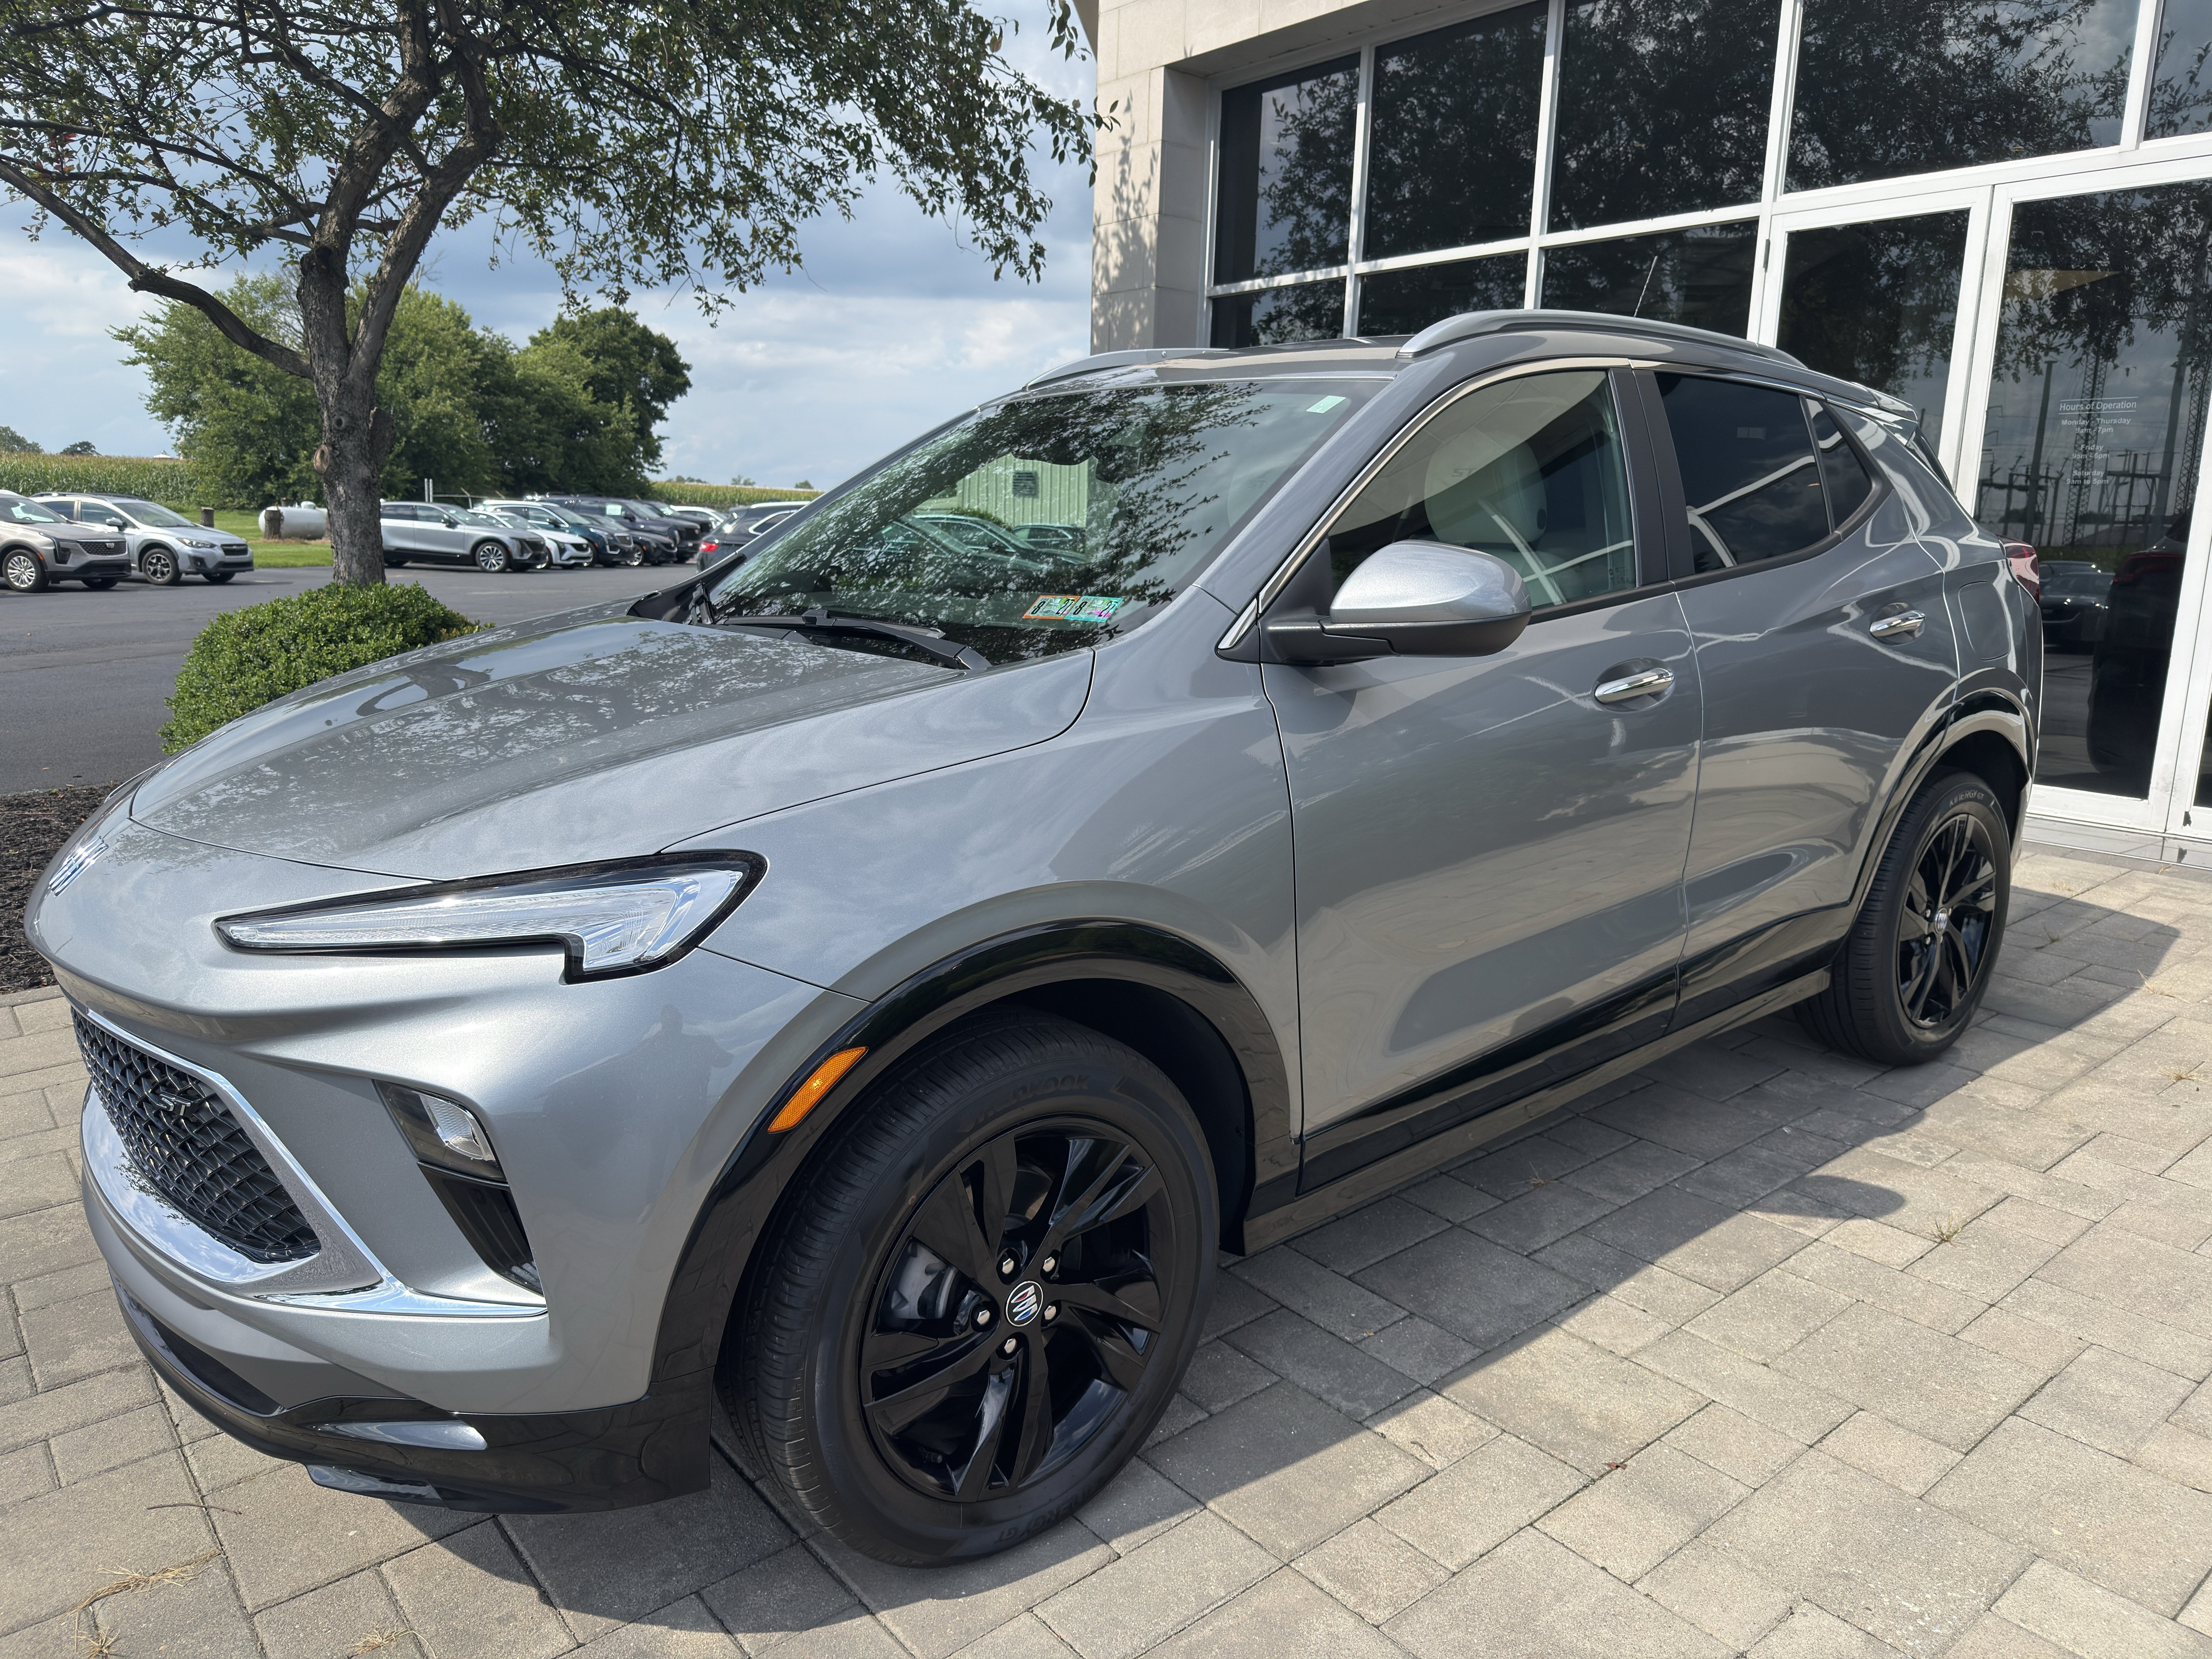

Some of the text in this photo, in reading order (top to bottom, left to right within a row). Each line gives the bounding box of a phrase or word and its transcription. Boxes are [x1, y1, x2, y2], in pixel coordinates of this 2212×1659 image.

[2086, 402, 2094, 410] of
[2096, 400, 2137, 411] Operation
[1451, 468, 1477, 477] ST
[1031, 599, 1076, 614] 8 27
[1073, 601, 1118, 617] 8 27
[156, 1094, 191, 1116] ST
